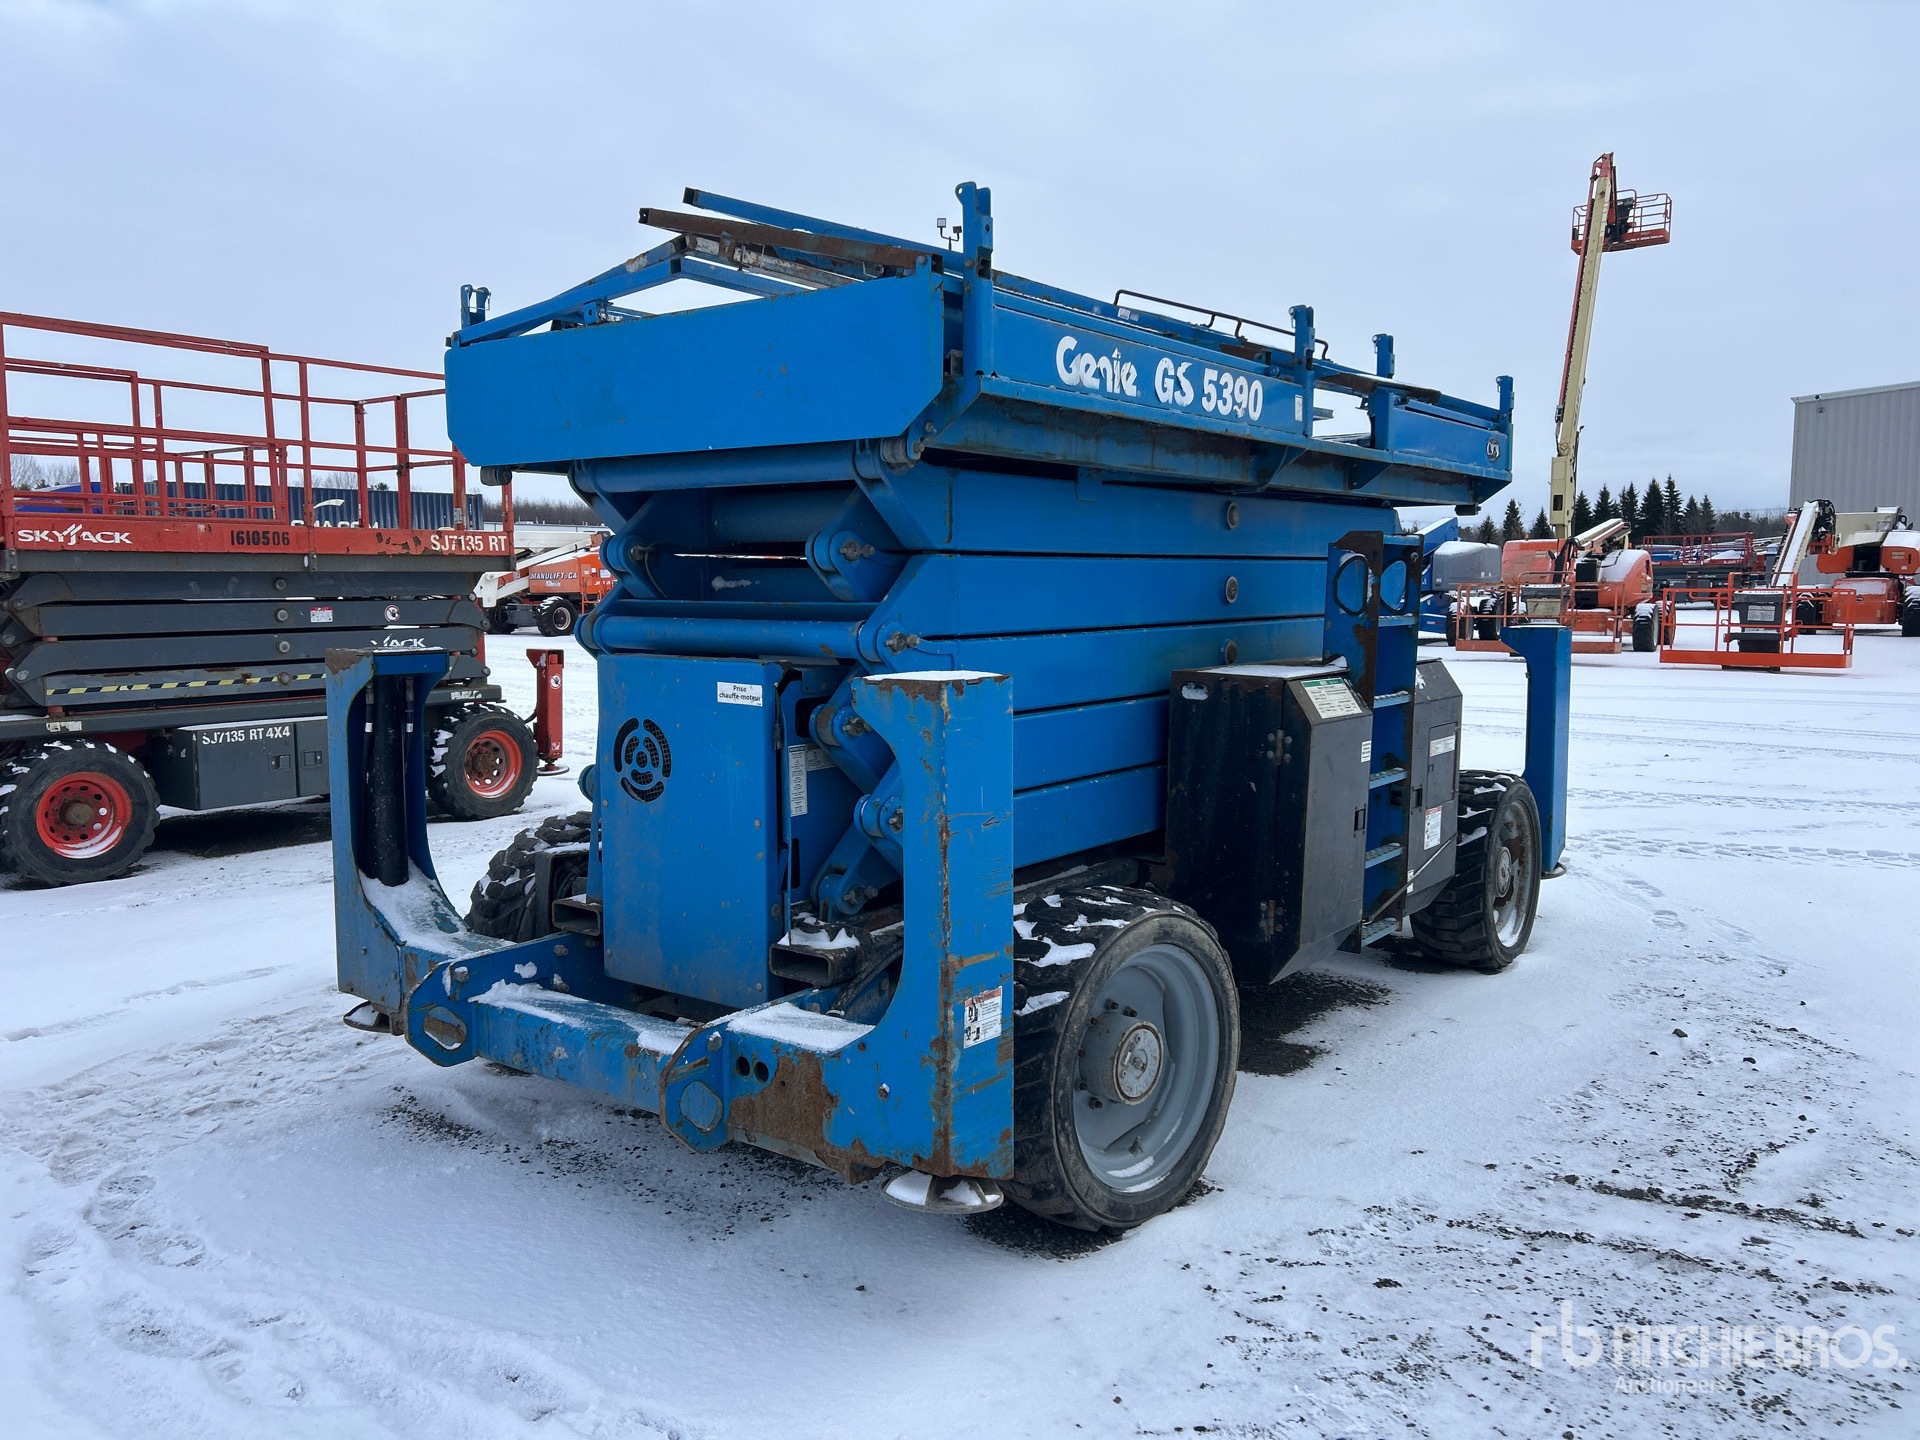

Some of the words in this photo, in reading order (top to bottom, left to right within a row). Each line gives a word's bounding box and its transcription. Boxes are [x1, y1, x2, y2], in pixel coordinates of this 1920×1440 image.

[1055, 335, 1138, 397] Genie
[1154, 357, 1195, 407] GS
[1201, 367, 1264, 421] 5390
[17, 523, 132, 546] SKYJACK
[430, 534, 484, 551] SJ7135
[488, 535, 507, 552] RT
[718, 691, 762, 702] chauffe-moteur
[732, 684, 747, 692] Prise
[202, 730, 245, 745] SJ7135
[249, 727, 265, 741] RT
[265, 725, 291, 739] 4X4
